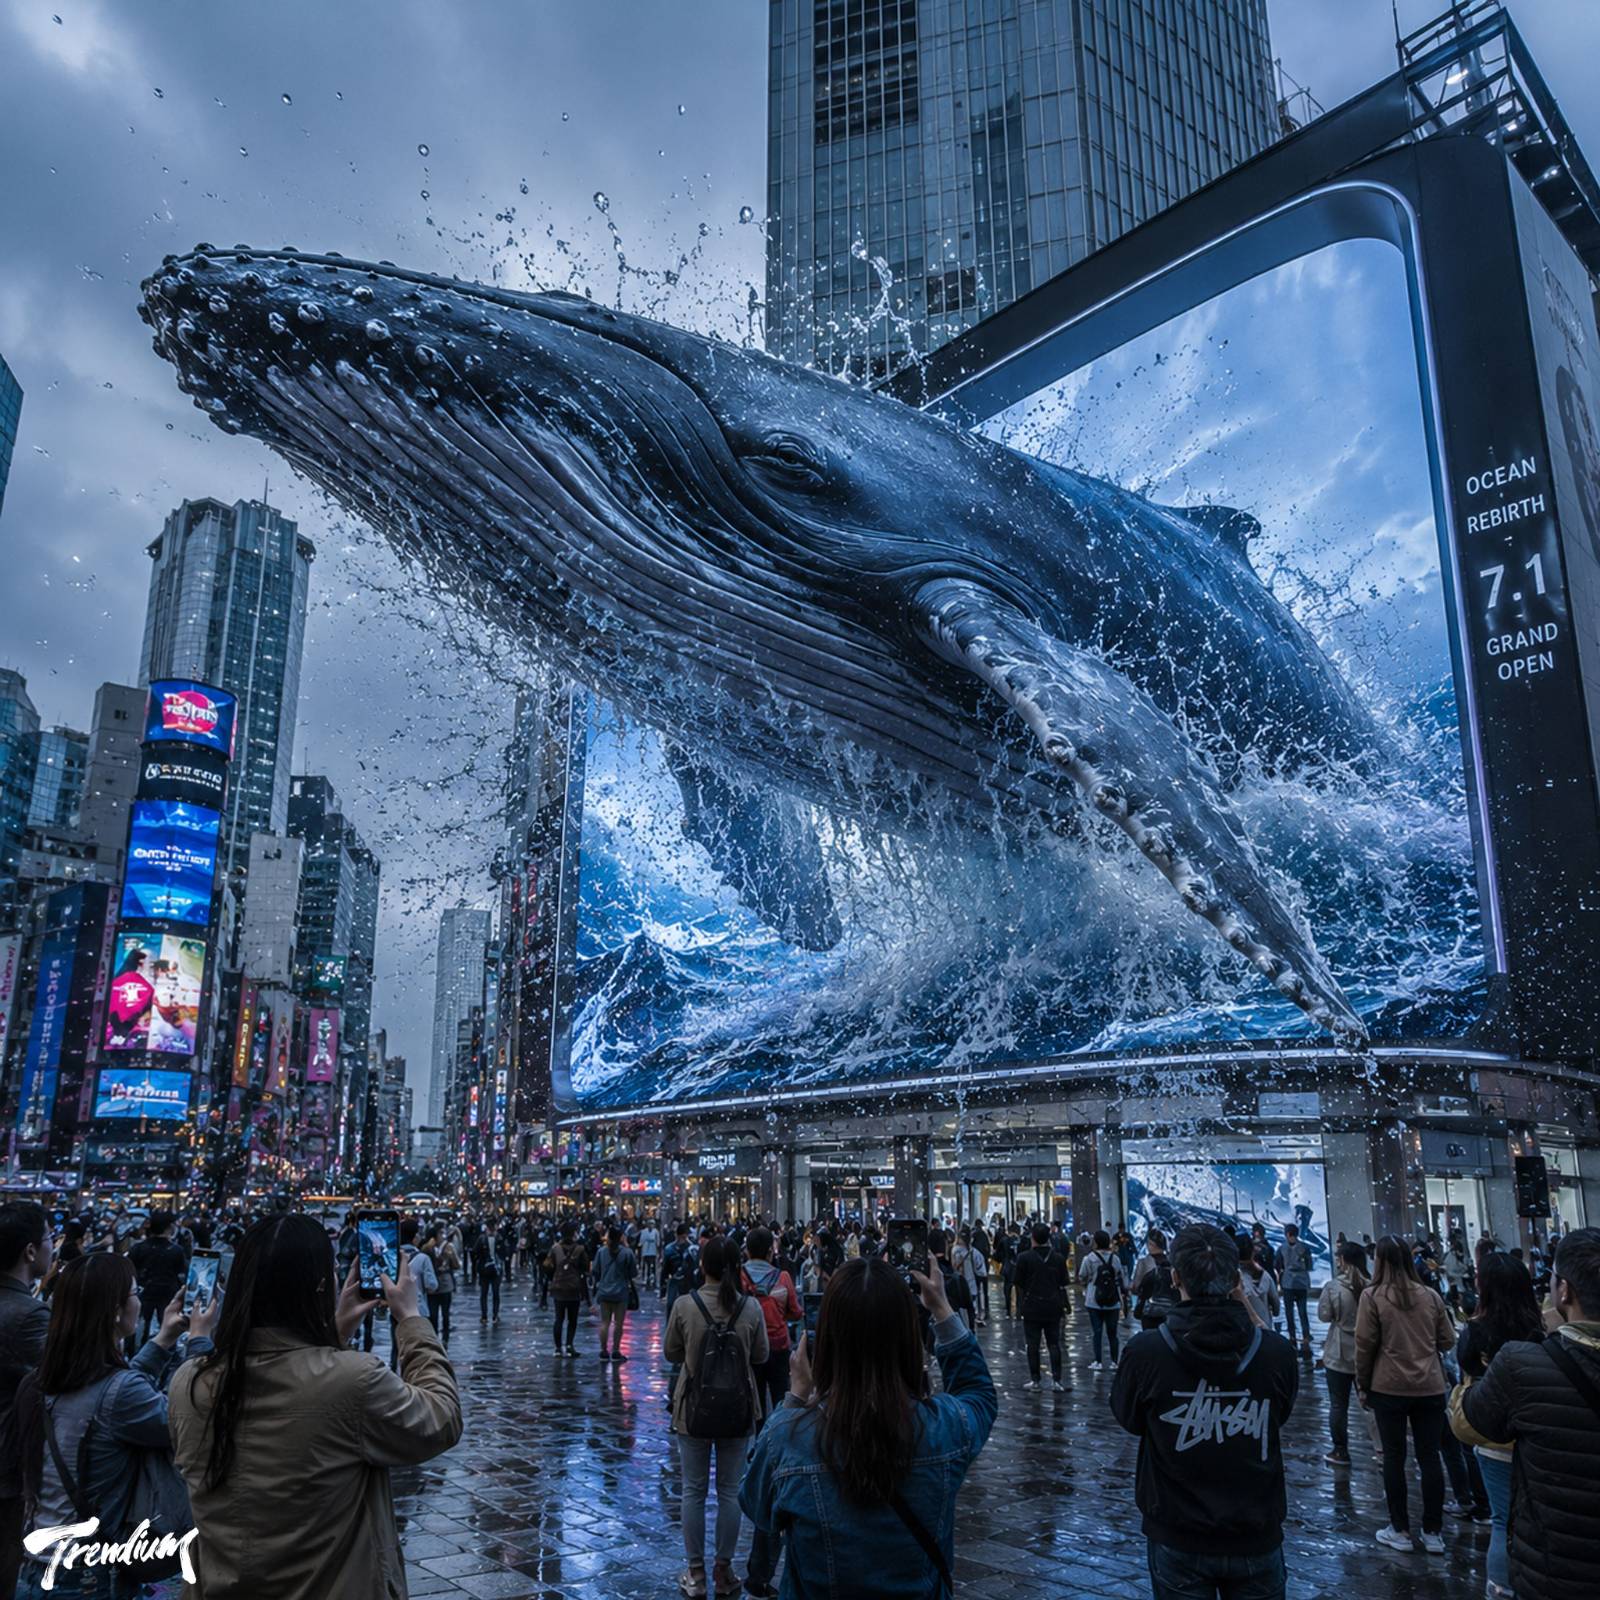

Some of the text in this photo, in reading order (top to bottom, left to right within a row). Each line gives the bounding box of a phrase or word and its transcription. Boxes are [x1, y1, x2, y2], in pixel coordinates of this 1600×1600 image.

[1466, 456, 1537, 495] OCEAN
[1467, 494, 1545, 534] REBIRTH
[1480, 553, 1546, 609] 7.1
[1487, 622, 1559, 656] GRAND
[1498, 651, 1554, 680] OPEN
